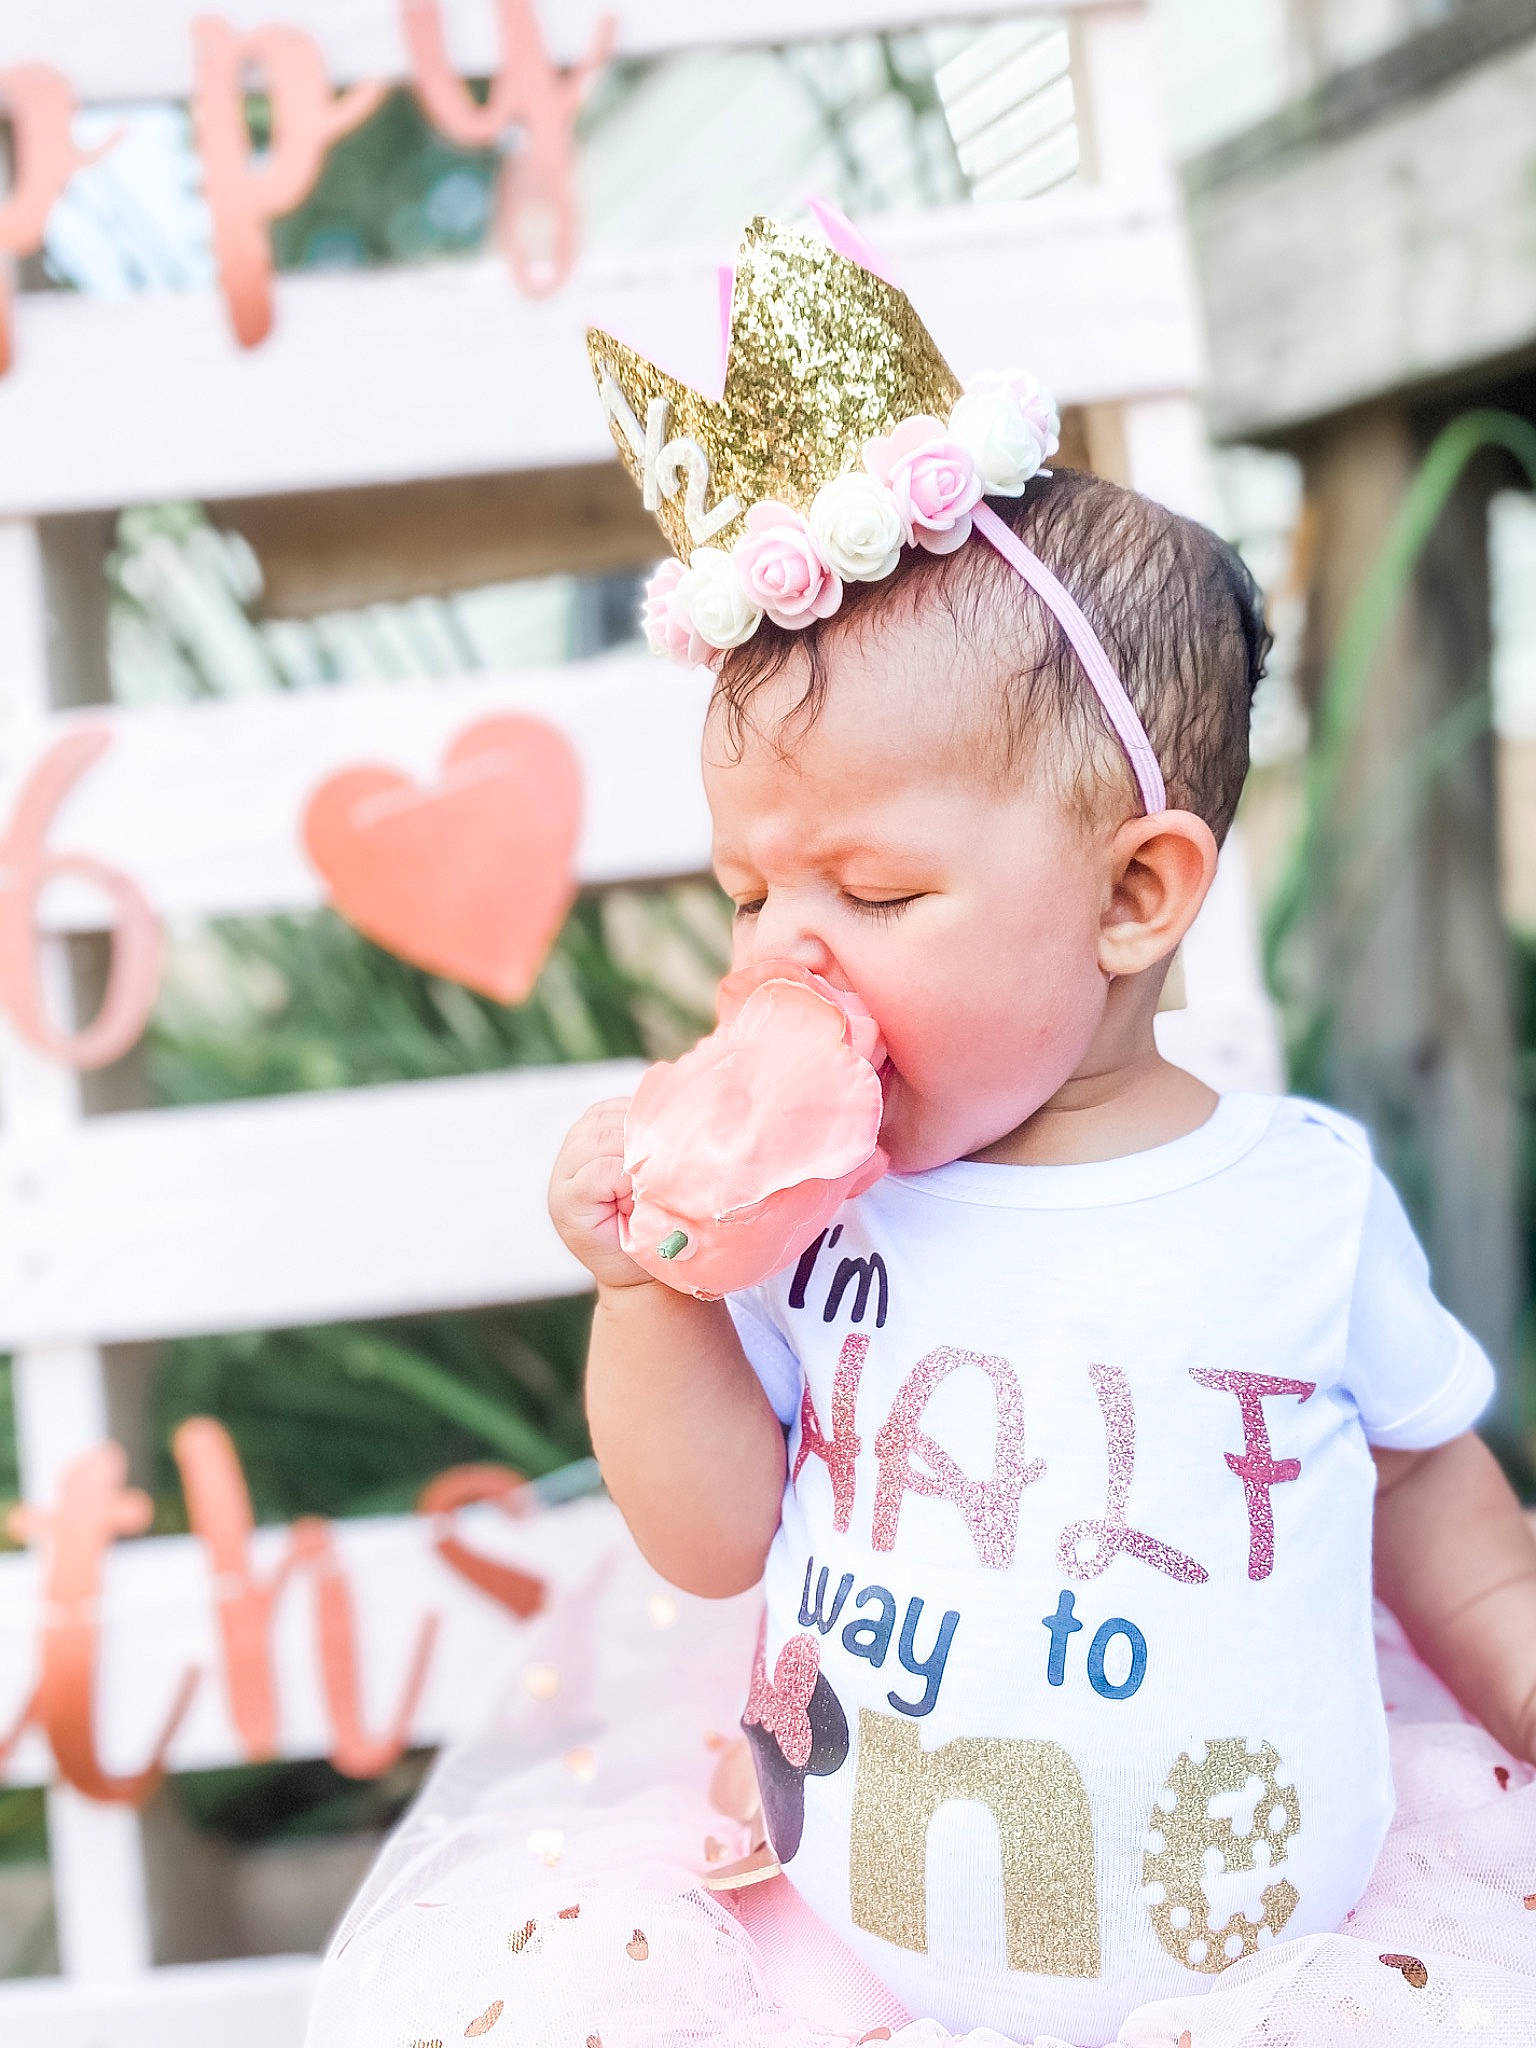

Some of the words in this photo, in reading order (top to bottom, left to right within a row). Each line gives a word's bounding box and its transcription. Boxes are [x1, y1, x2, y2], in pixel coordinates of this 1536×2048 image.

[0, 716, 163, 1069] 6
[788, 1224, 888, 1328] I'm
[791, 1333, 1316, 1585] HALF
[797, 1556, 960, 1717] way
[1042, 1589, 1148, 1700] to
